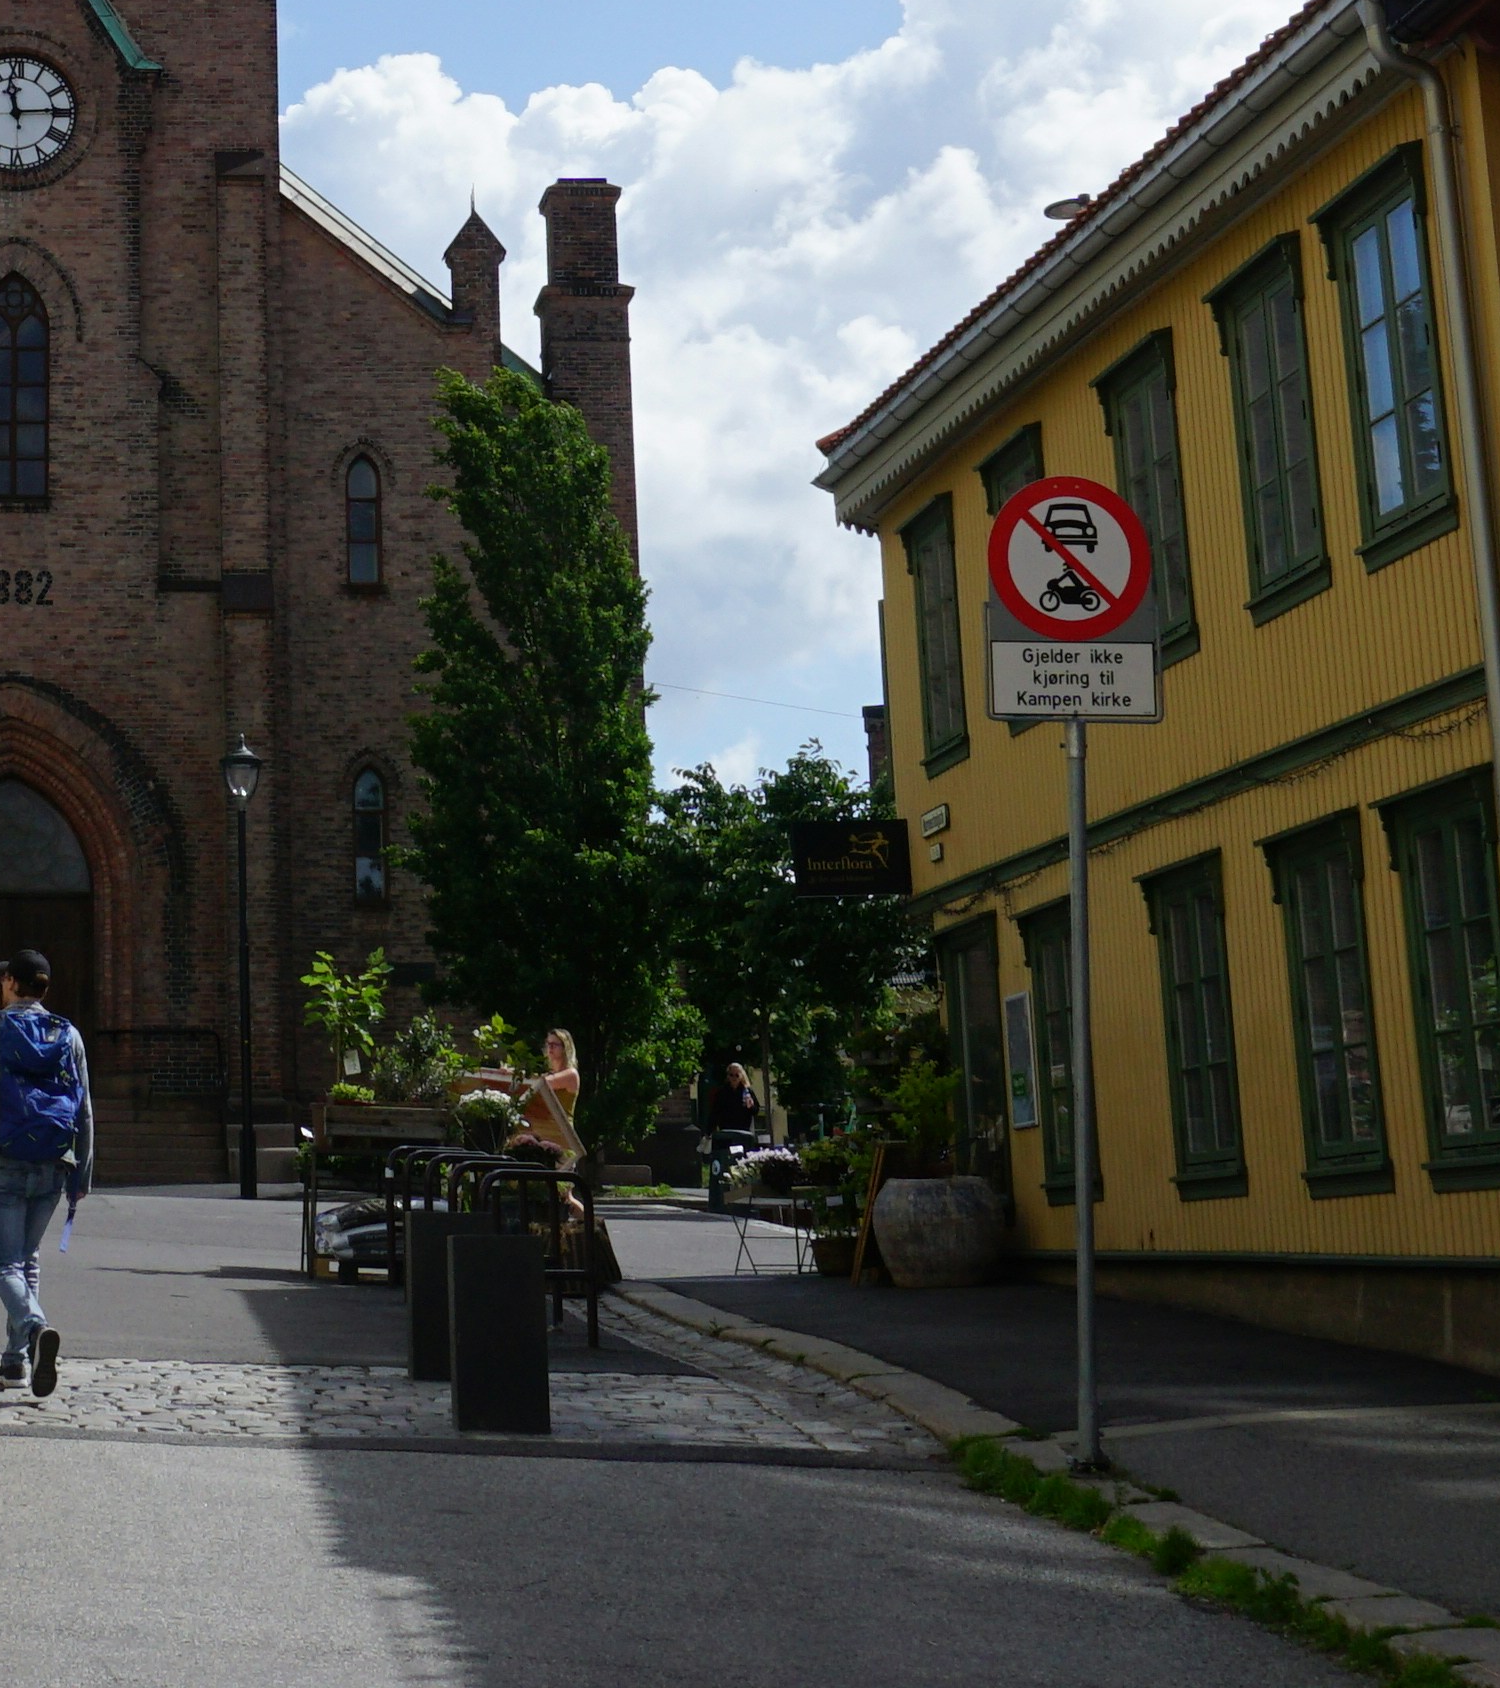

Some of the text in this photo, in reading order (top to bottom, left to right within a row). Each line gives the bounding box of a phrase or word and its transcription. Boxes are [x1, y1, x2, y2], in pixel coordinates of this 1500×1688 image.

[1022, 648, 1123, 667] Gjelder ikke
[1033, 670, 1114, 688] kjøring til
[1017, 691, 1132, 709] Kampen kirke
[807, 855, 873, 871] Interflora
